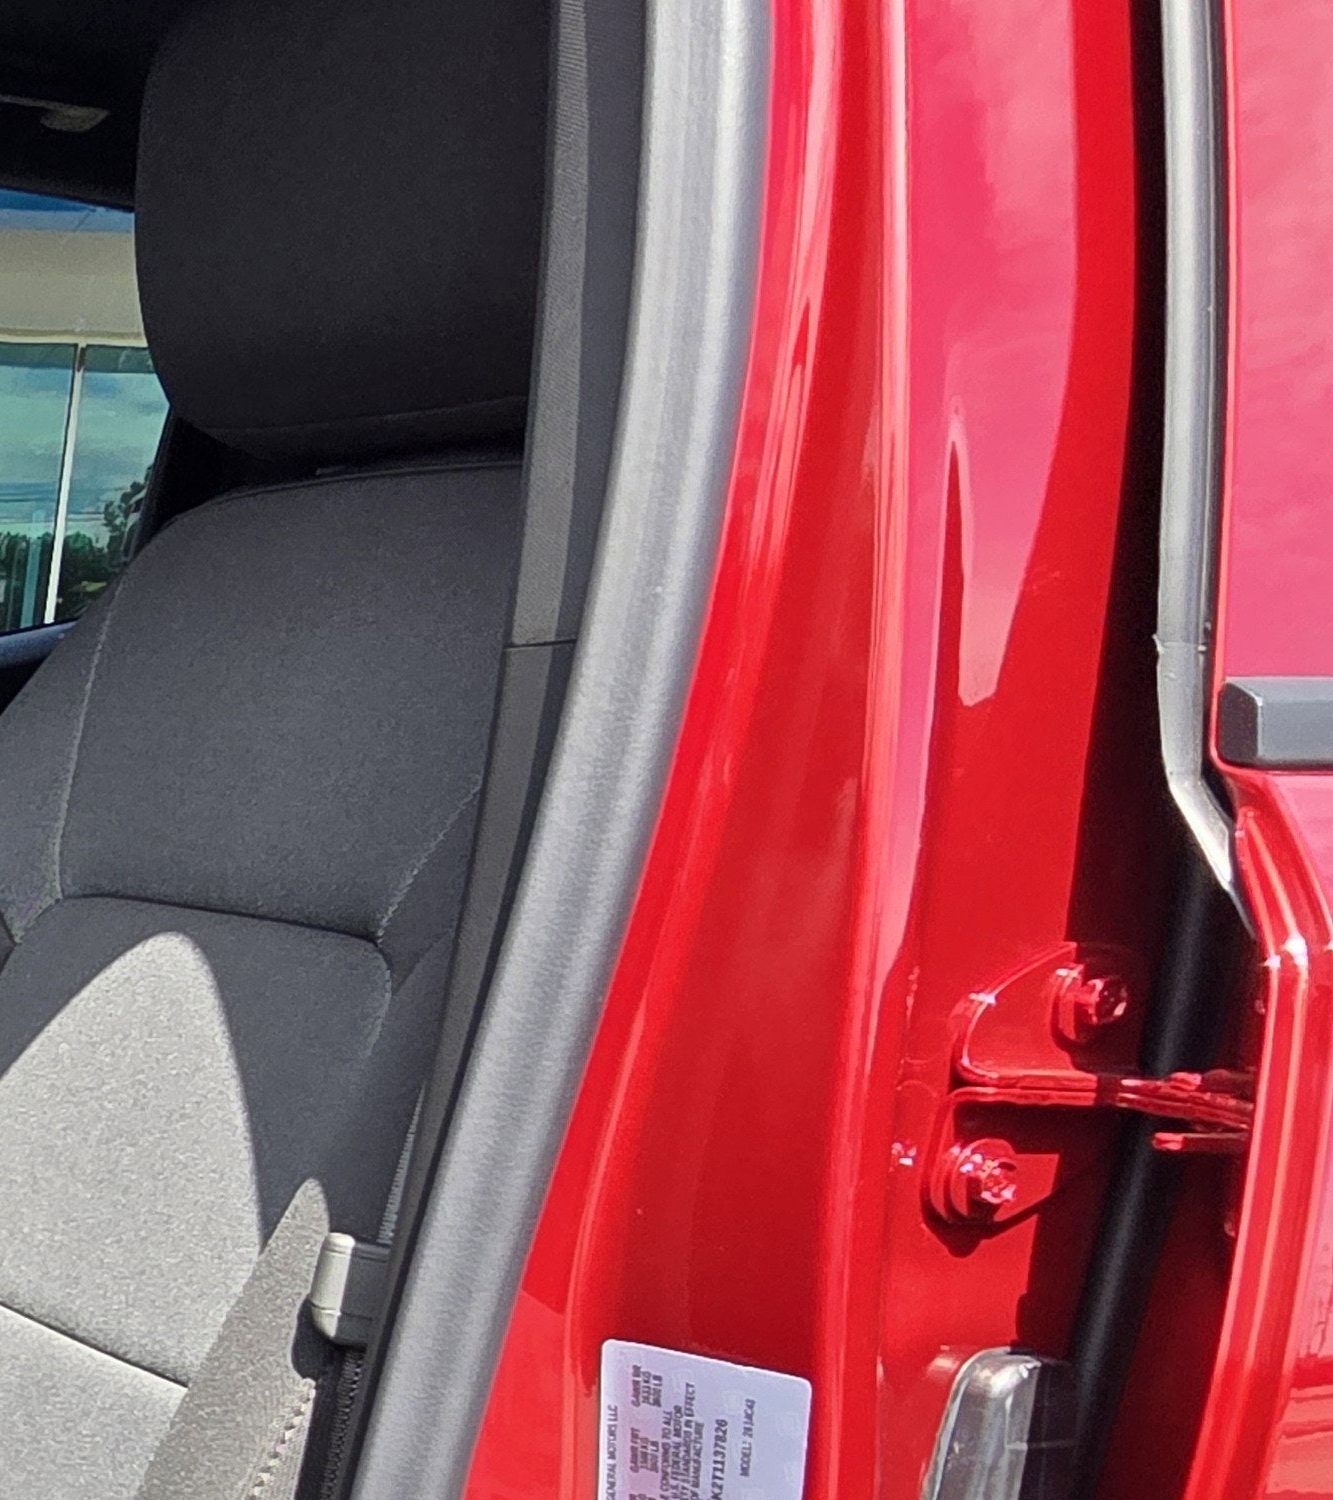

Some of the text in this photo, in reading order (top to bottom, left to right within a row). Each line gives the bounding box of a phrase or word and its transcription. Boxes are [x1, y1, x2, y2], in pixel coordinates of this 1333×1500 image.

[684, 1382, 695, 1418] EFFECT
[608, 1405, 617, 1422] LLC
[663, 1410, 672, 1426] ALL
[673, 1405, 683, 1438] MOTOR
[607, 1424, 617, 1460] MOTORS
[661, 1428, 671, 1439] TO
